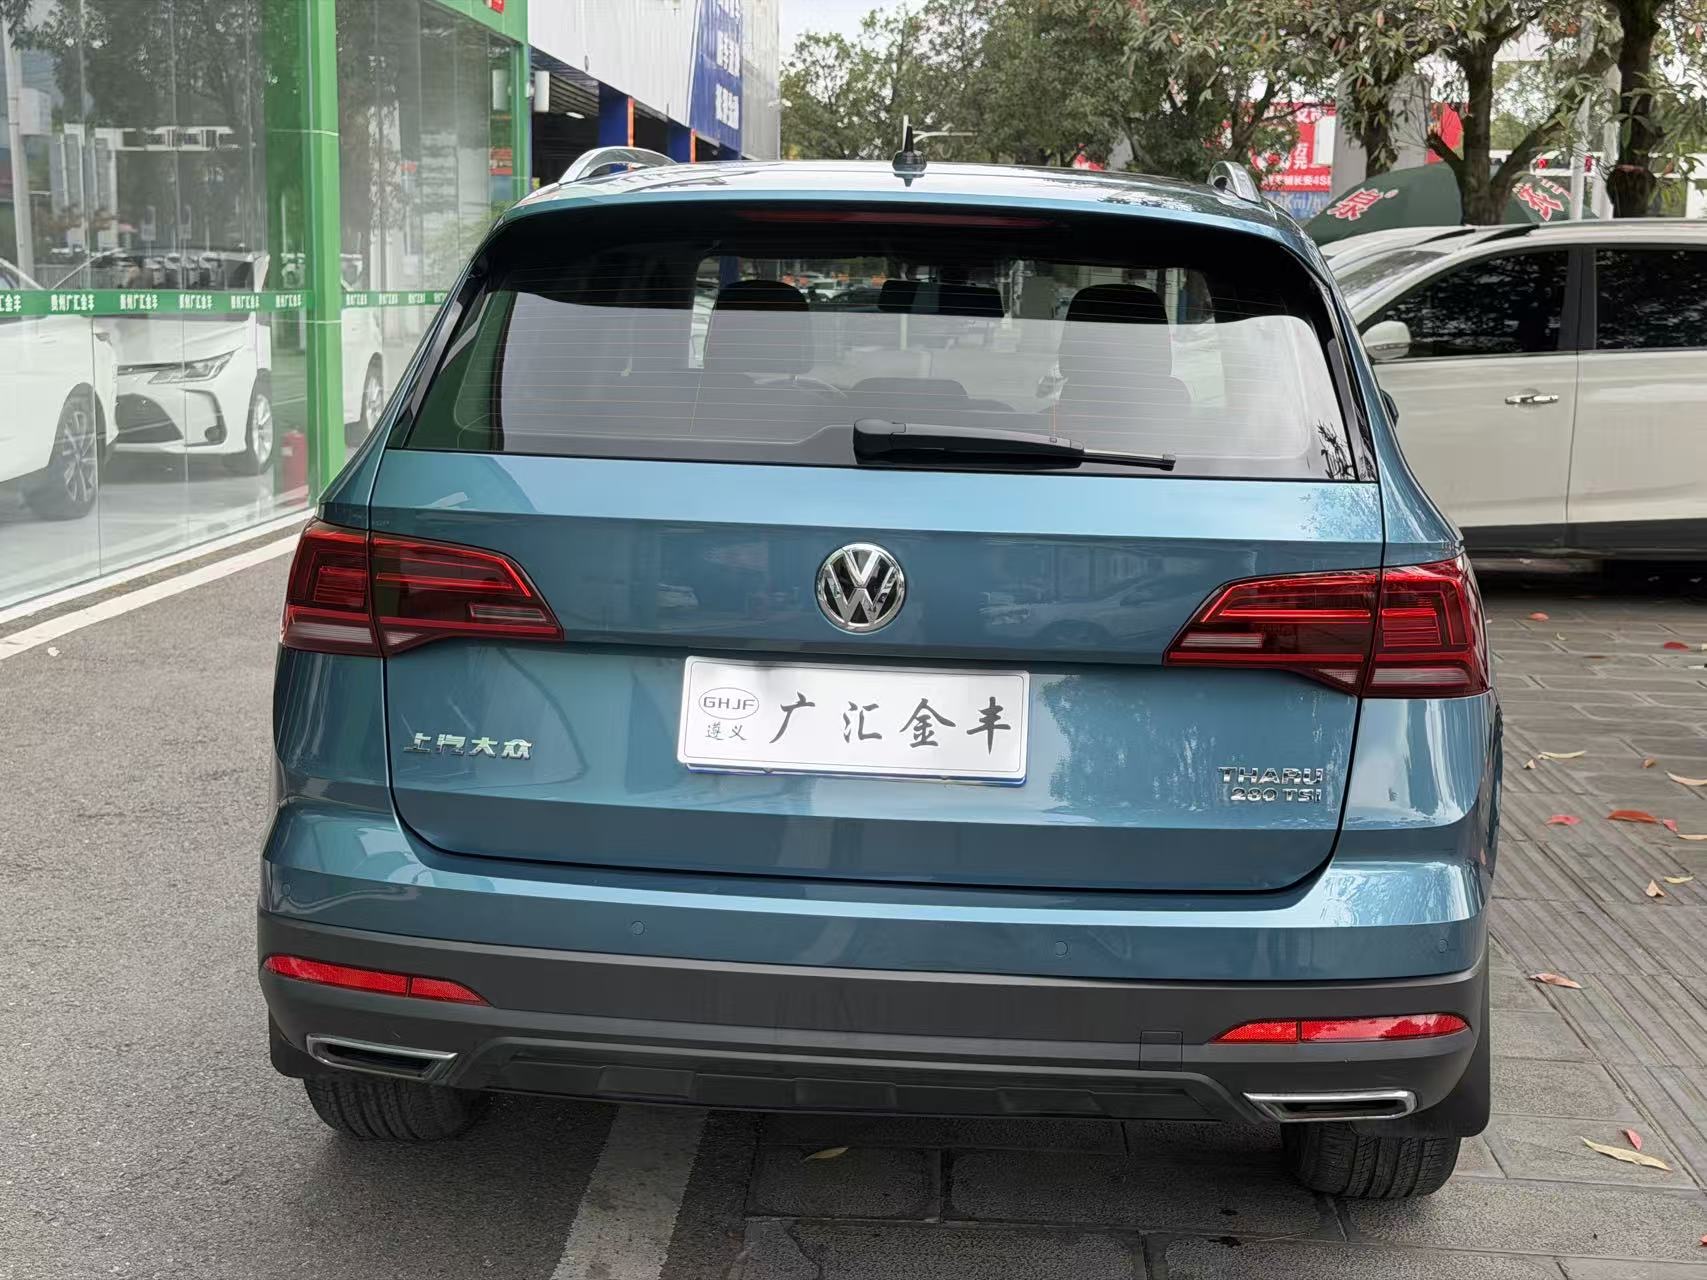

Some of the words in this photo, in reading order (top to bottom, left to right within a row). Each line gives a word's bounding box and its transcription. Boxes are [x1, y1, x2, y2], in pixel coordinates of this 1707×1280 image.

[703, 696, 756, 711] GHJF
[705, 721, 748, 741] 遵义
[768, 691, 1012, 755] 广汇金丰
[403, 732, 533, 760] 上汽大众
[1218, 766, 1324, 785] THARU
[1230, 786, 1278, 802] 280
[1282, 787, 1322, 802] TSI
